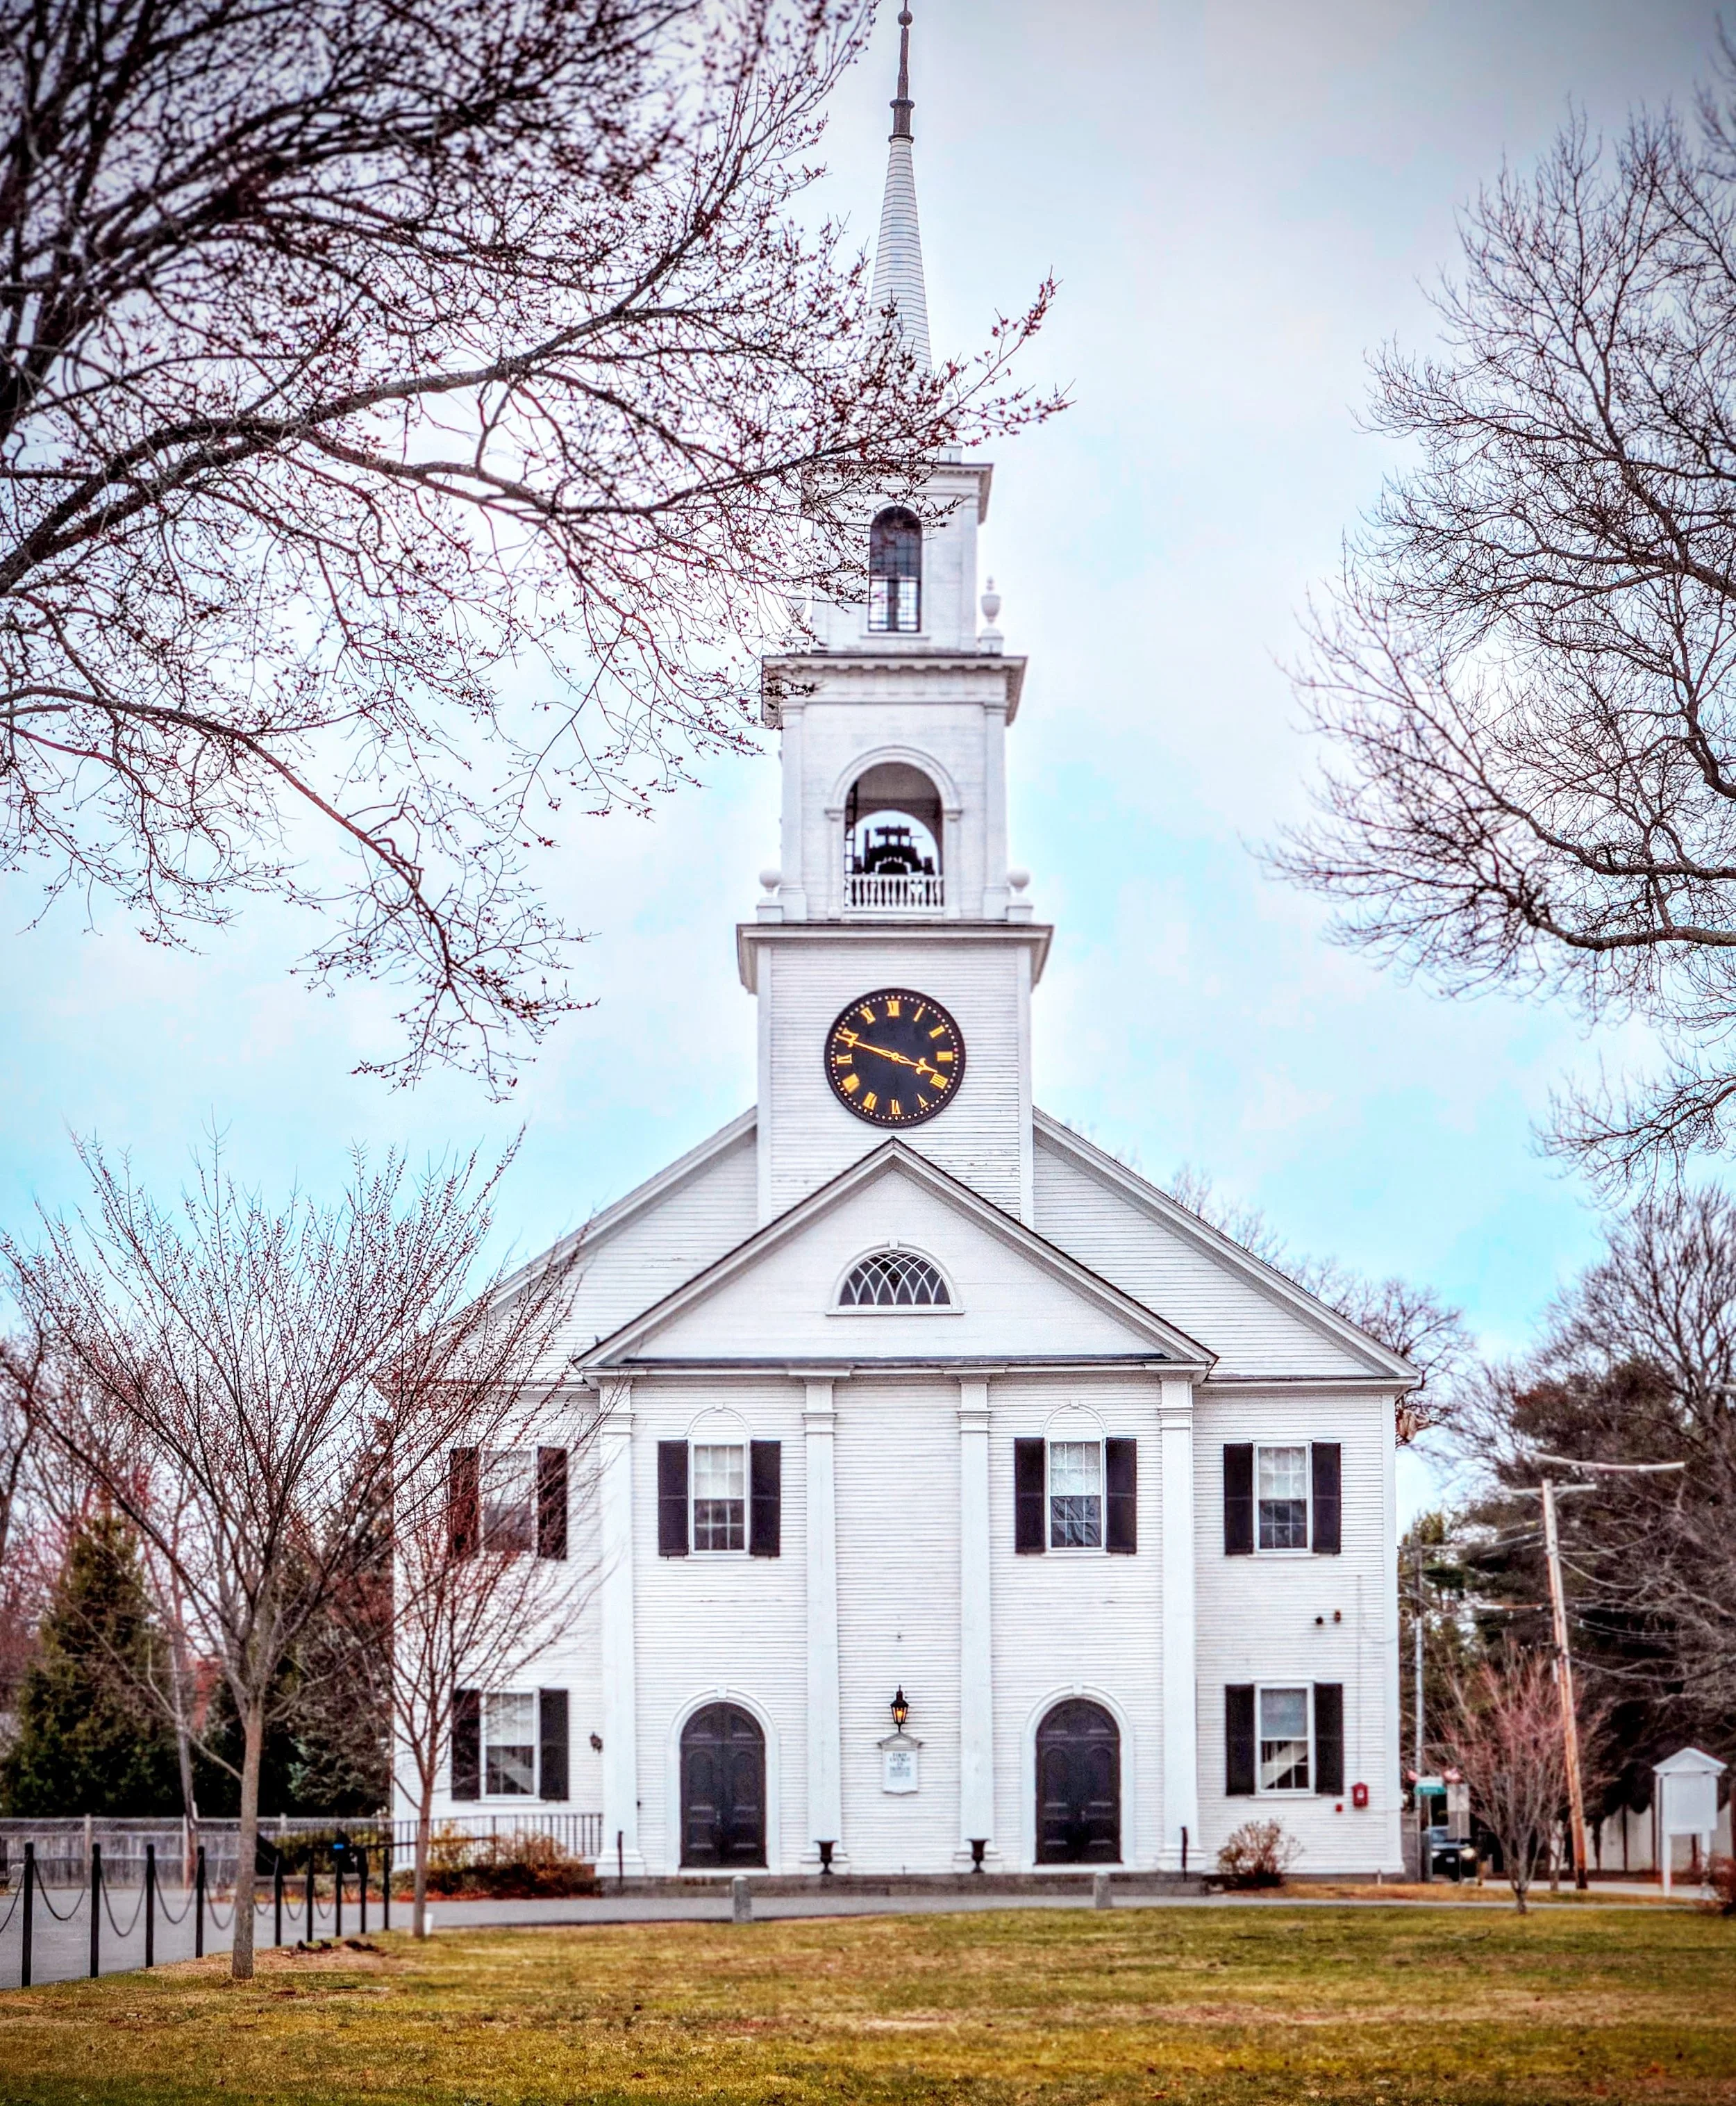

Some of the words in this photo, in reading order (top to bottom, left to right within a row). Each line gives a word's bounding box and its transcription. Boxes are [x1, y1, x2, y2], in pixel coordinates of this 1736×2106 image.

[913, 1006, 924, 1022] I
[928, 1025, 945, 1038] II
[937, 1051, 953, 1061] III
